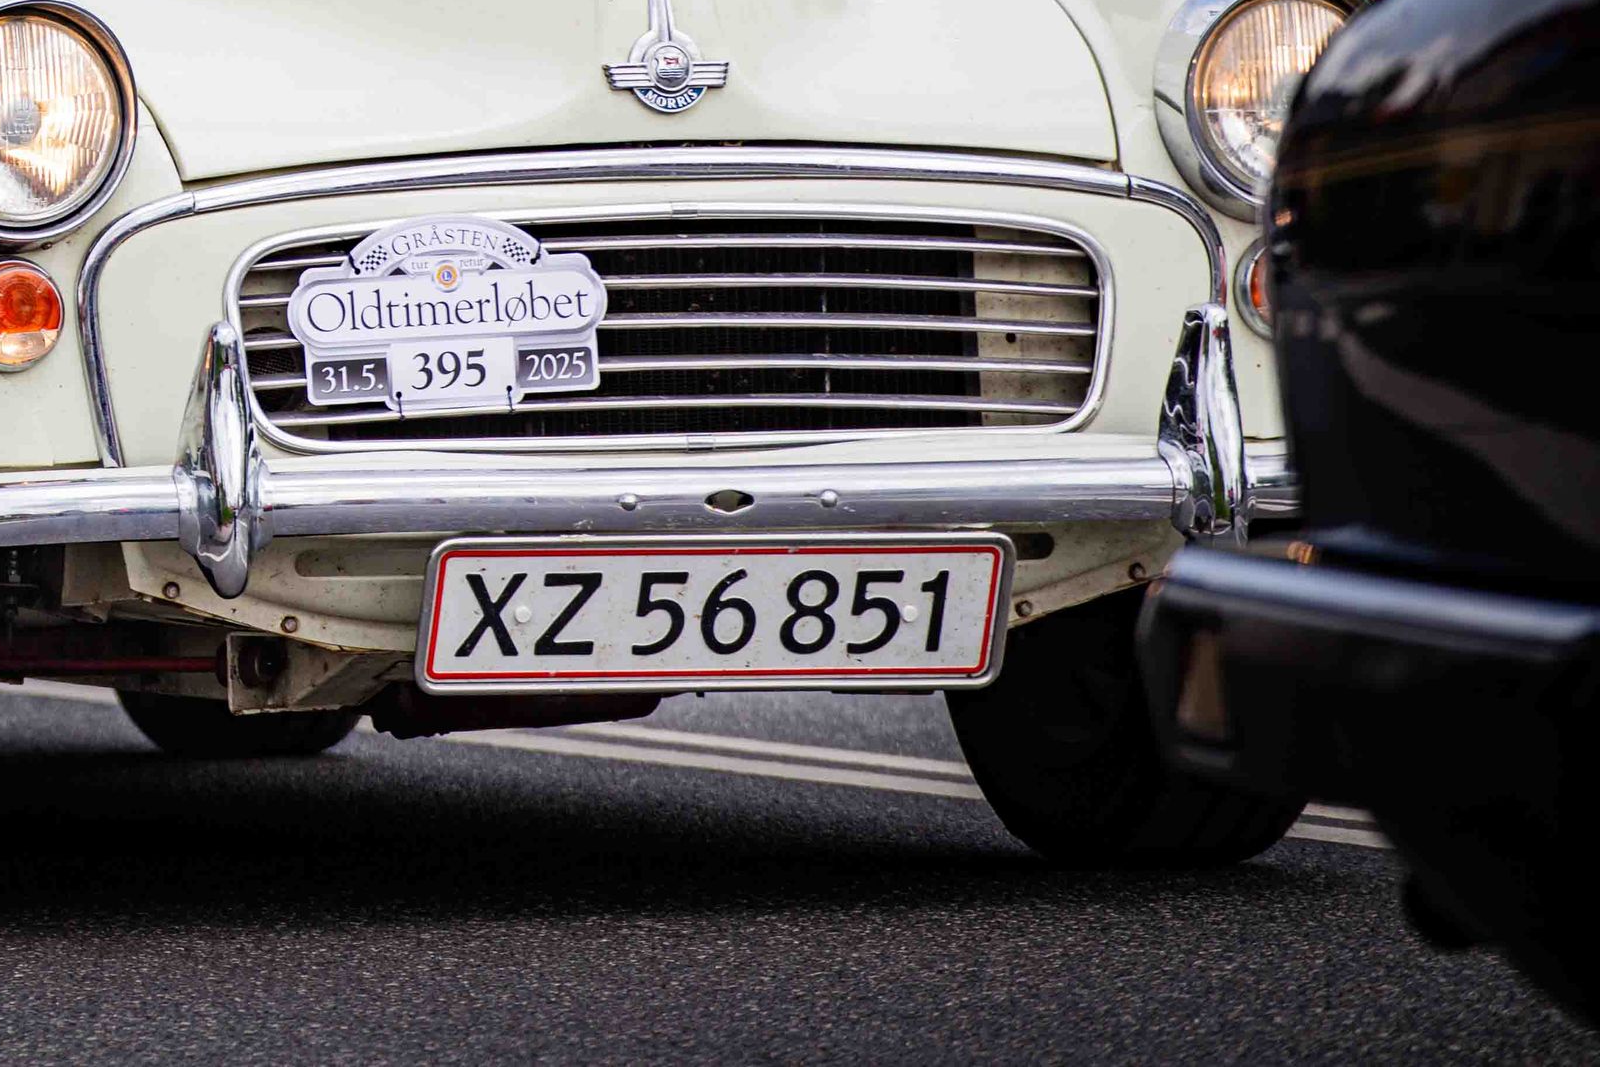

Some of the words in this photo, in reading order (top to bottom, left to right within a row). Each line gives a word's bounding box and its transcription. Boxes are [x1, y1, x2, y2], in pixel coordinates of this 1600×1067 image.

[644, 87, 699, 109] MORRIS
[390, 224, 499, 257] GRÅSTEN
[306, 279, 591, 333] Oldtimerløbet
[411, 348, 488, 390] 395
[525, 350, 588, 382] 2025
[453, 572, 603, 658] XZ
[630, 568, 757, 656] 56
[778, 569, 950, 655] 851
